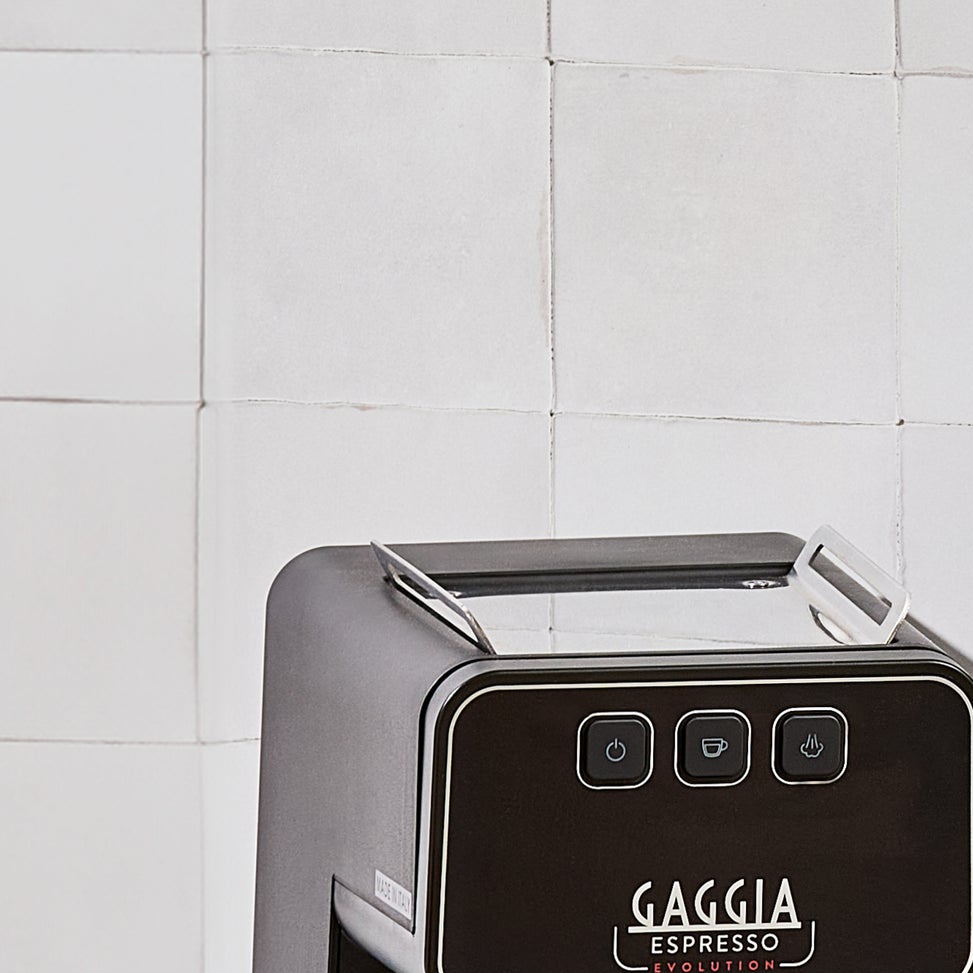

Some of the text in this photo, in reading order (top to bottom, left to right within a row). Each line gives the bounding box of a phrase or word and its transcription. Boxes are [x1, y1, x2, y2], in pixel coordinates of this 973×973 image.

[632, 878, 798, 927] GAGGIA
[651, 933, 779, 954] ESPRESSO
[654, 960, 775, 973] EVOLUTION
